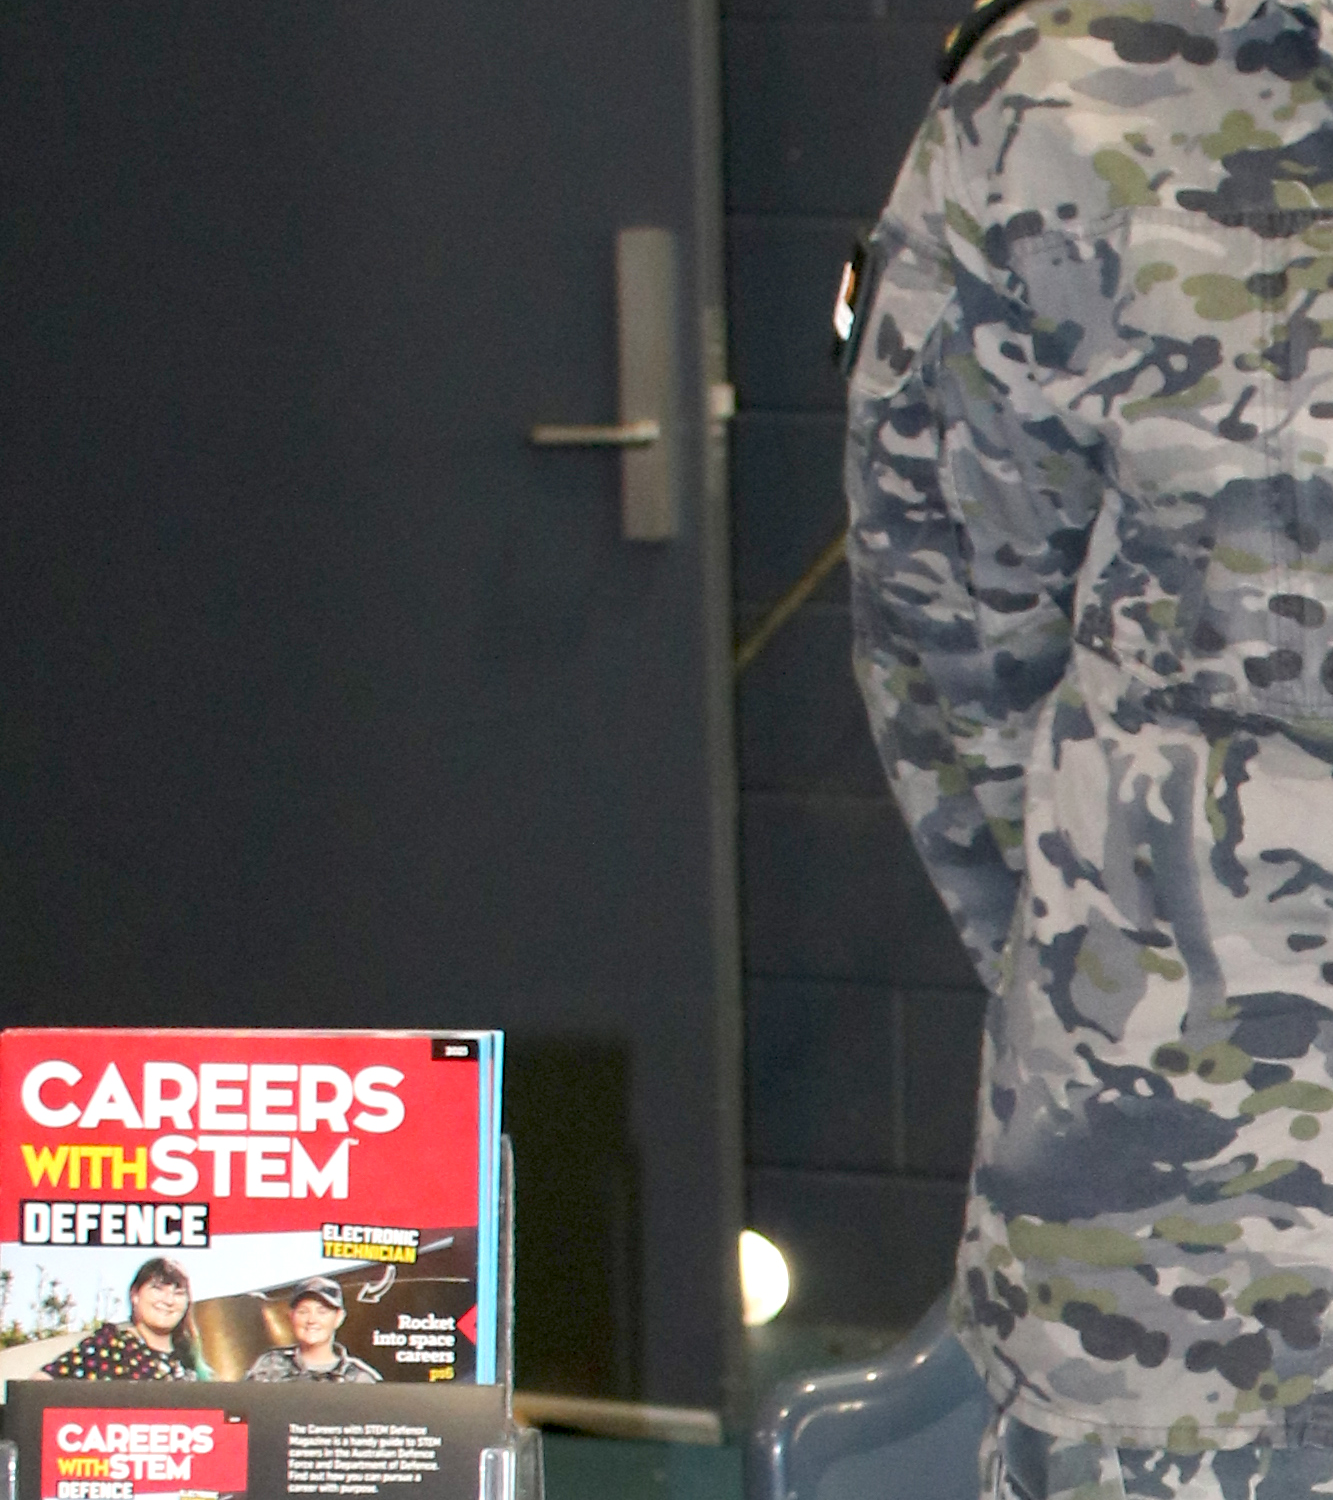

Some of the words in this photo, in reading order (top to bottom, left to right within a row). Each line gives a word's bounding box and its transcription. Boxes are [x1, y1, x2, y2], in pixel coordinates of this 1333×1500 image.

[21, 1059, 406, 1133] CAREERS
[21, 1144, 148, 1190] WITH
[23, 1204, 208, 1245] DEFENCE
[322, 1224, 419, 1246] ELECTRONIC
[324, 1242, 417, 1263] TECHNICIAN
[398, 1312, 456, 1331] Rocket
[372, 1329, 407, 1346] into
[409, 1334, 456, 1350] space
[395, 1350, 456, 1363] careers
[57, 1423, 214, 1453] CAREERS
[307, 1423, 343, 1435] Careers
[343, 1425, 363, 1434] with
[364, 1424, 389, 1435] STEM
[389, 1425, 428, 1436] Defence
[289, 1436, 331, 1448] Magazine
[350, 1437, 378, 1448] handy
[379, 1437, 404, 1448] guide
[417, 1436, 442, 1447] STEM
[288, 1449, 323, 1458] careers
[351, 1449, 397, 1458] Australian
[398, 1449, 436, 1459] Defence
[57, 1457, 109, 1477] WITH
[288, 1459, 314, 1470] Force
[315, 1460, 333, 1470] and
[334, 1460, 387, 1471] Department
[288, 1472, 309, 1481] Find
[309, 1472, 325, 1481] out
[326, 1472, 345, 1481] how
[345, 1474, 364, 1483] you
[364, 1474, 382, 1482] can
[382, 1473, 413, 1483] pursue
[58, 1481, 133, 1499] DEFENCE
[287, 1483, 318, 1493] career
[319, 1483, 339, 1493] with
